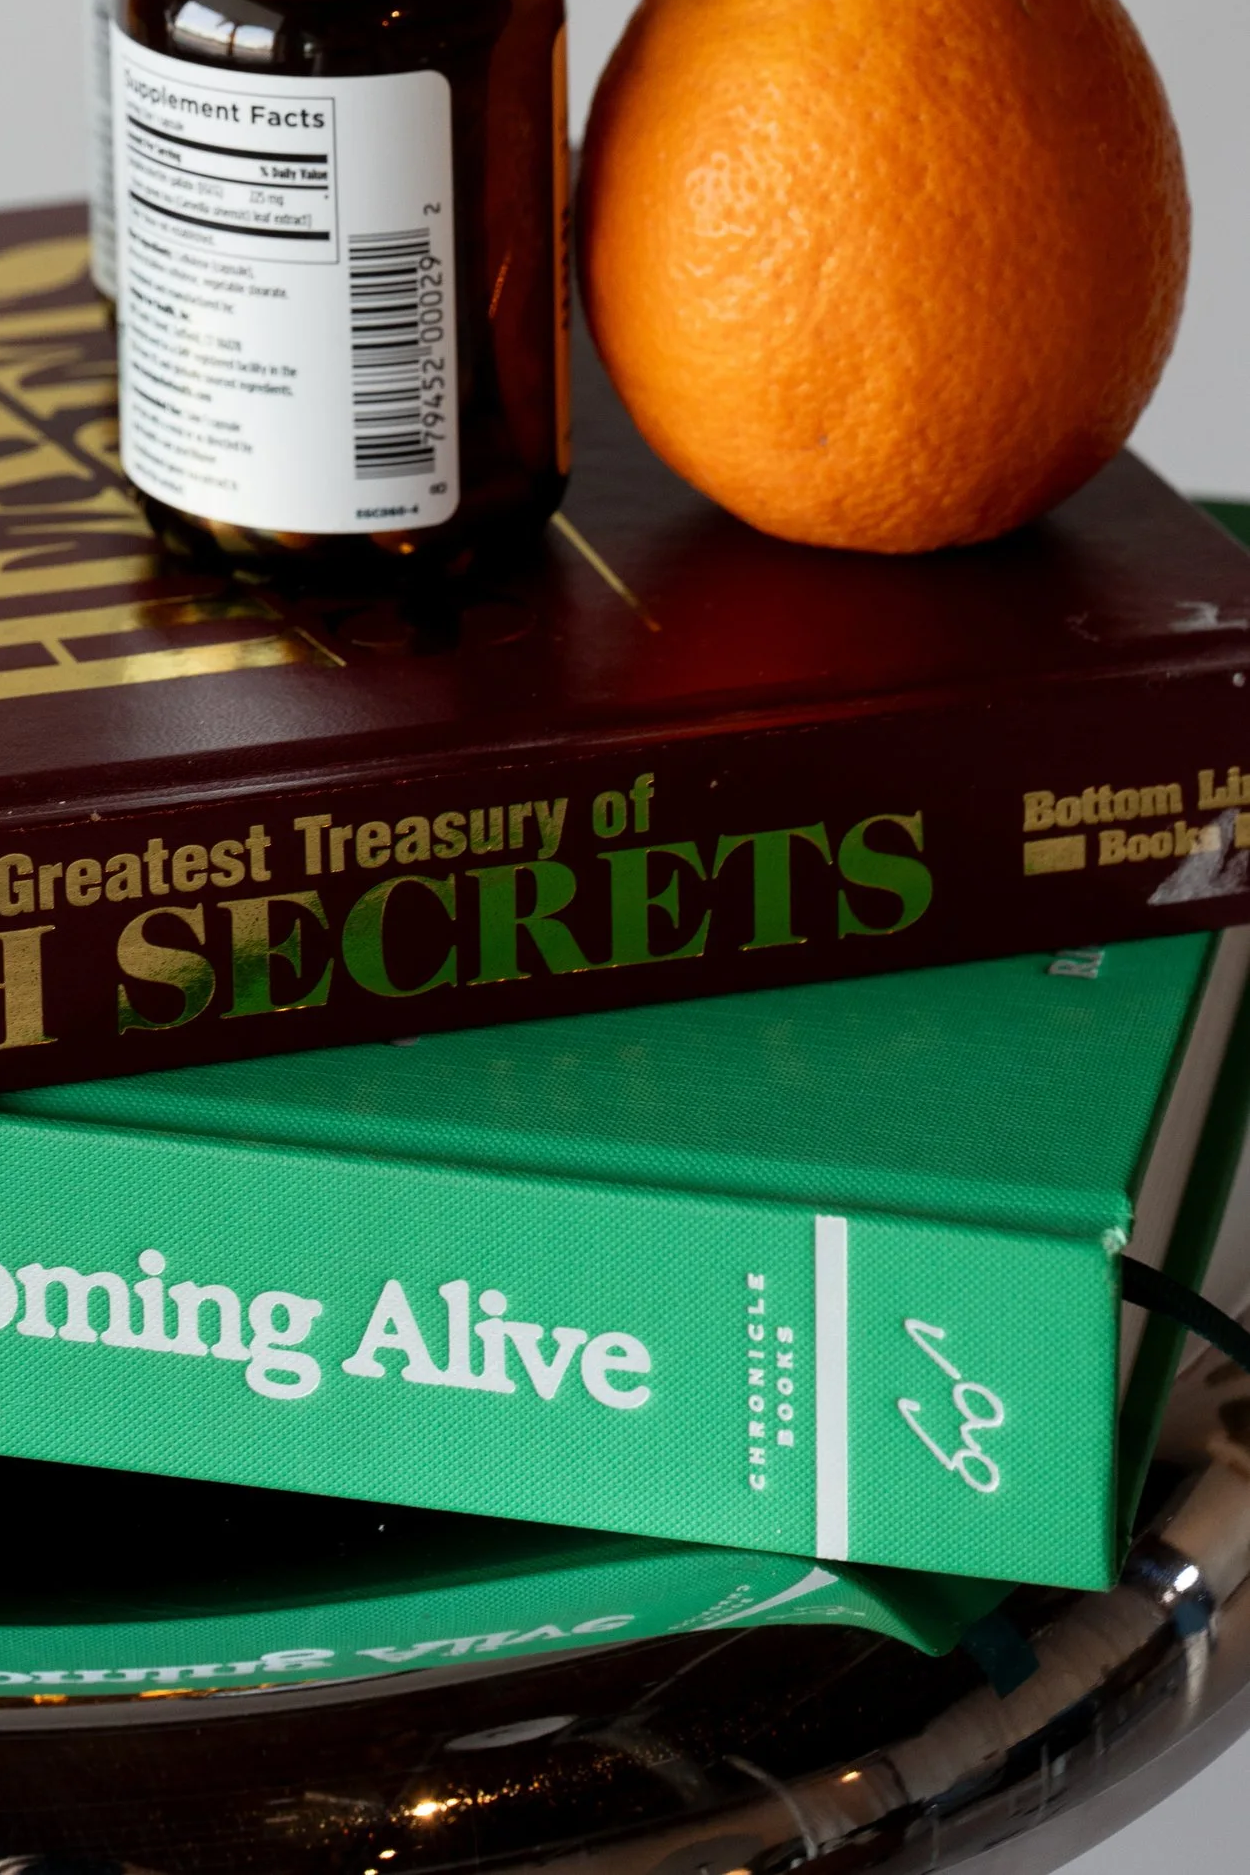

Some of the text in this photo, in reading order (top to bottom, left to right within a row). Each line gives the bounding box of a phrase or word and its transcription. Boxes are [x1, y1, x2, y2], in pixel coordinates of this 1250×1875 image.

[125, 69, 240, 123] Supplement
[250, 105, 326, 129] Facts
[272, 167, 297, 181] Daily
[299, 169, 328, 182] Value
[422, 201, 442, 217] 2
[418, 255, 444, 344] 00029
[421, 357, 446, 445] 79452
[292, 796, 569, 876] Treasury
[590, 772, 656, 839] of
[1022, 782, 1184, 833] Bottom
[116, 809, 935, 1037] SECRETS
[341, 1278, 653, 1412] Alive
[747, 1272, 767, 1491] CHRONICLE
[776, 1326, 795, 1448] BOOKS
